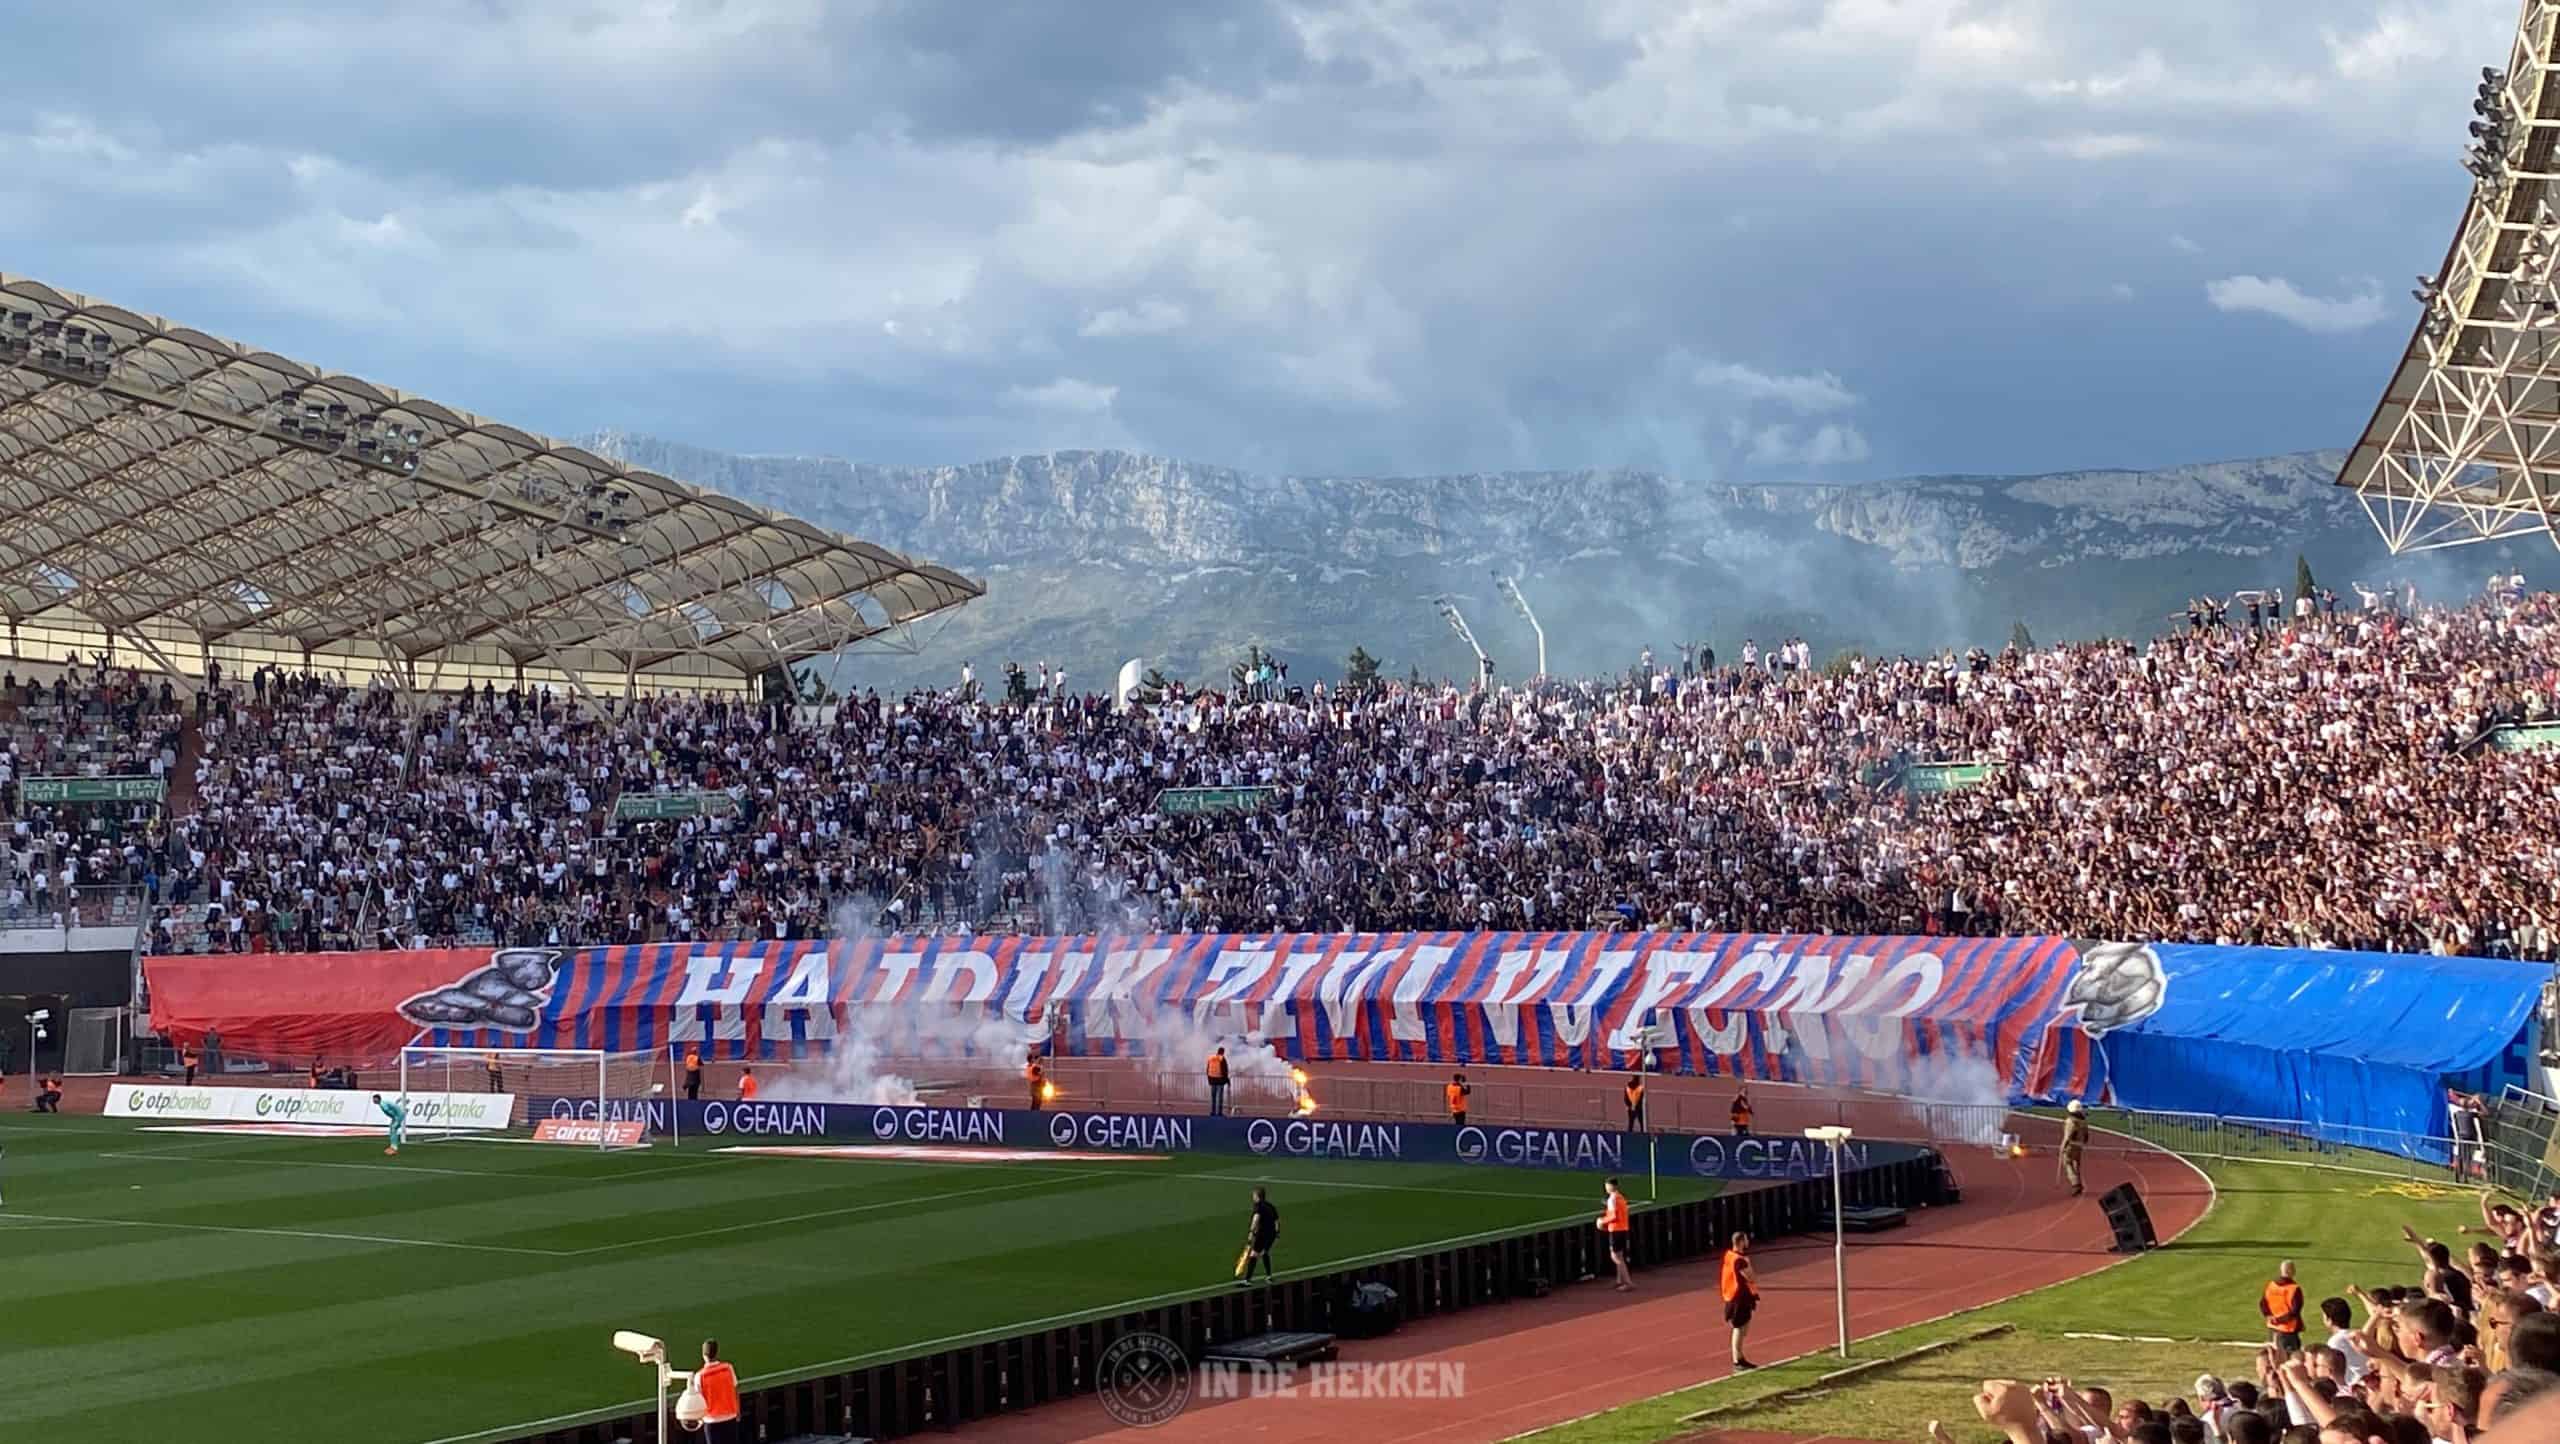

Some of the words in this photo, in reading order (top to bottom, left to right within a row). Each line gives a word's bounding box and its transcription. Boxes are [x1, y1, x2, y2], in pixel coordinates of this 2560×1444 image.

[733, 1104, 825, 1135] GEALAN
[904, 1108, 1003, 1143] GEALAN
[1084, 1115, 1191, 1149] GEALAN
[1285, 1120, 1400, 1158] GEALAN
[1496, 1129, 1622, 1168] GEALAN
